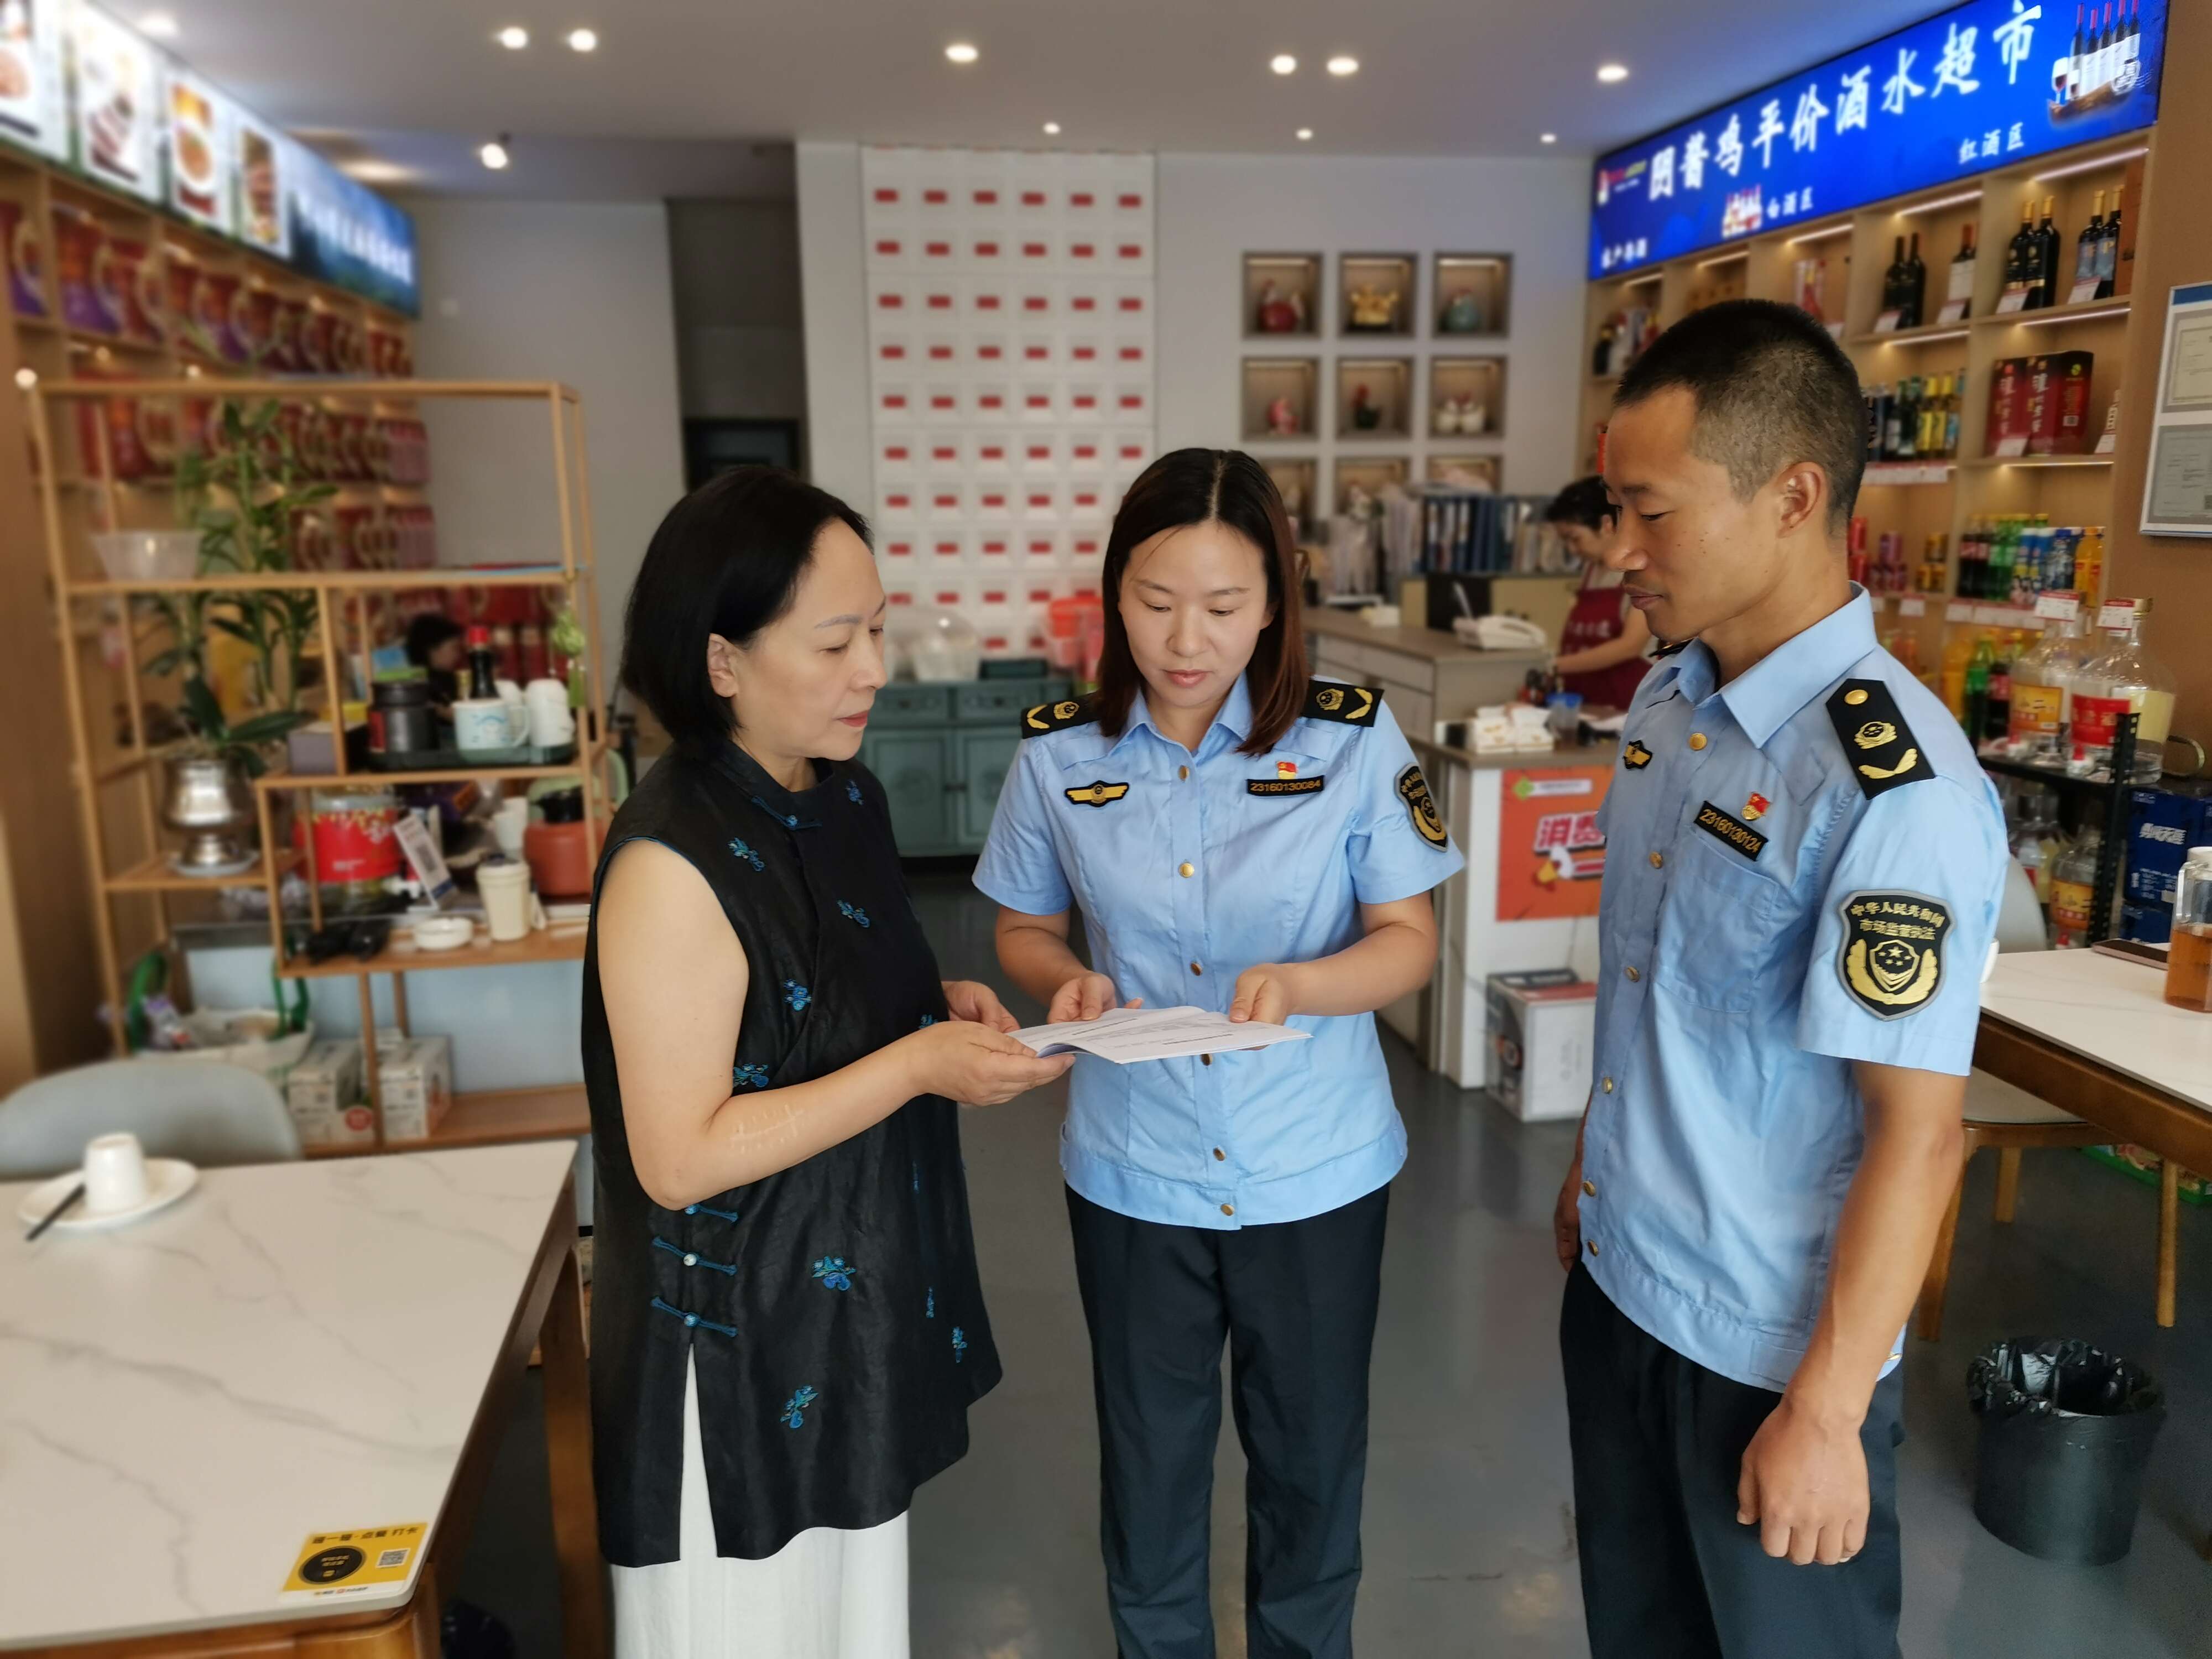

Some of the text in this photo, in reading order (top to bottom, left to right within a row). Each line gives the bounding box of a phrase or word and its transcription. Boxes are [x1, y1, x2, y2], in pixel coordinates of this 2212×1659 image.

[1958, 121, 2024, 165] 红酒区
[1850, 901, 1945, 928] 中华人民共和国
